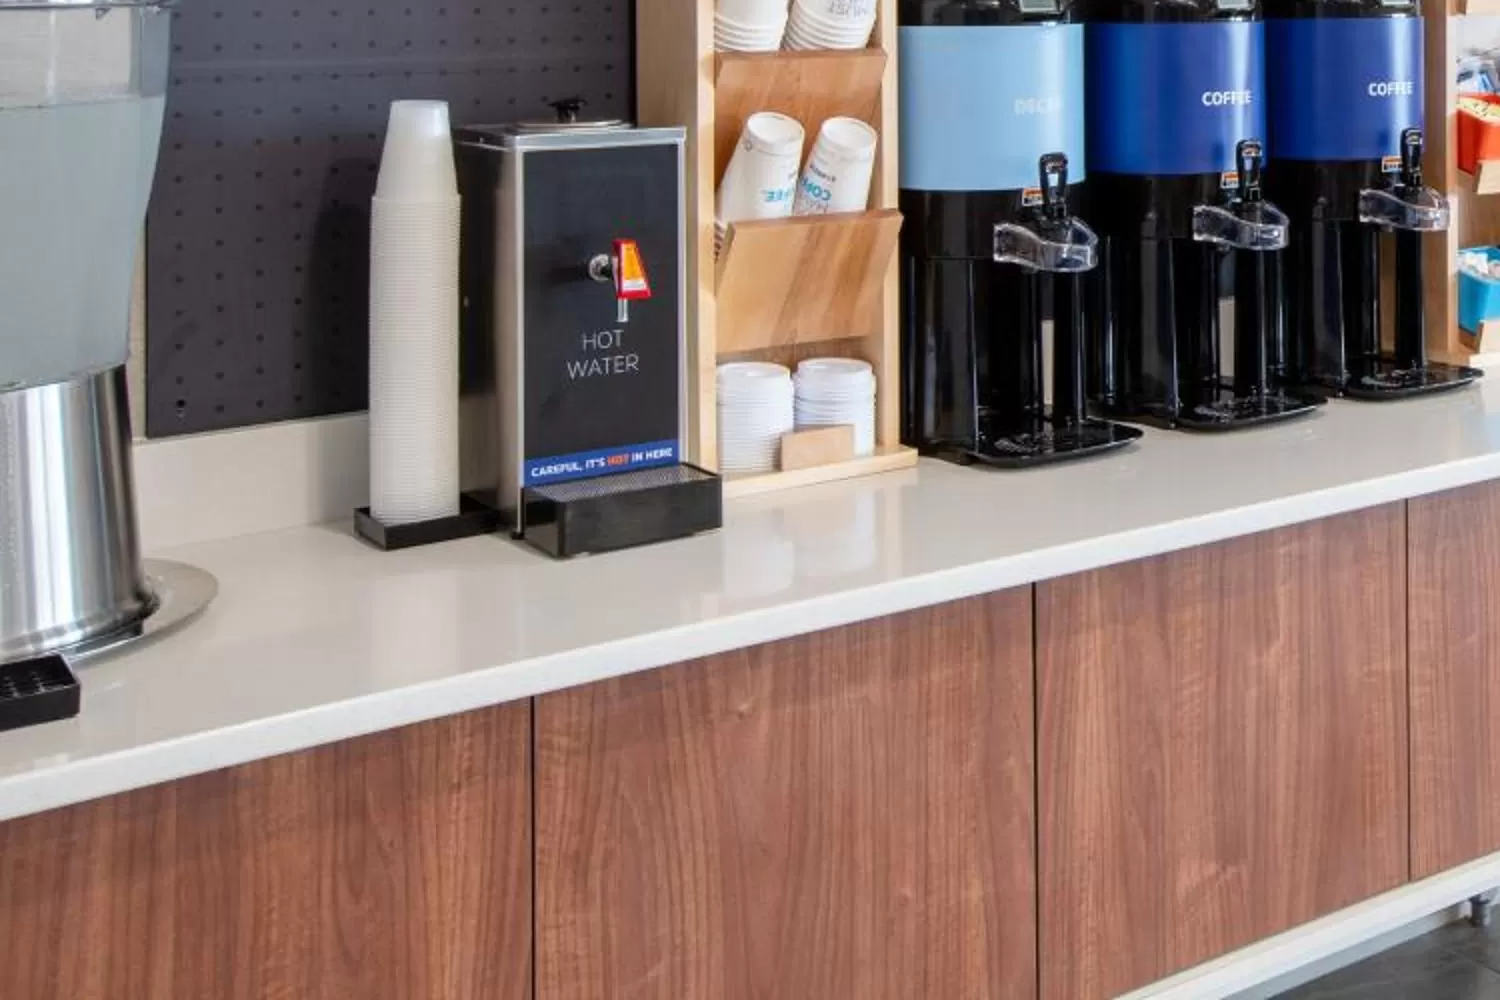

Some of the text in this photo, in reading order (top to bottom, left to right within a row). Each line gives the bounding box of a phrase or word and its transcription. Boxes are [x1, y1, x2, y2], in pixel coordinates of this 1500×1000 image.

[1202, 90, 1252, 107] COFFEE
[1368, 81, 1414, 97] COFFEE
[582, 329, 624, 351] HOT
[566, 353, 639, 380] WATER
[585, 457, 606, 469] IT'S
[607, 453, 629, 466] HOT
[631, 450, 643, 462] IN
